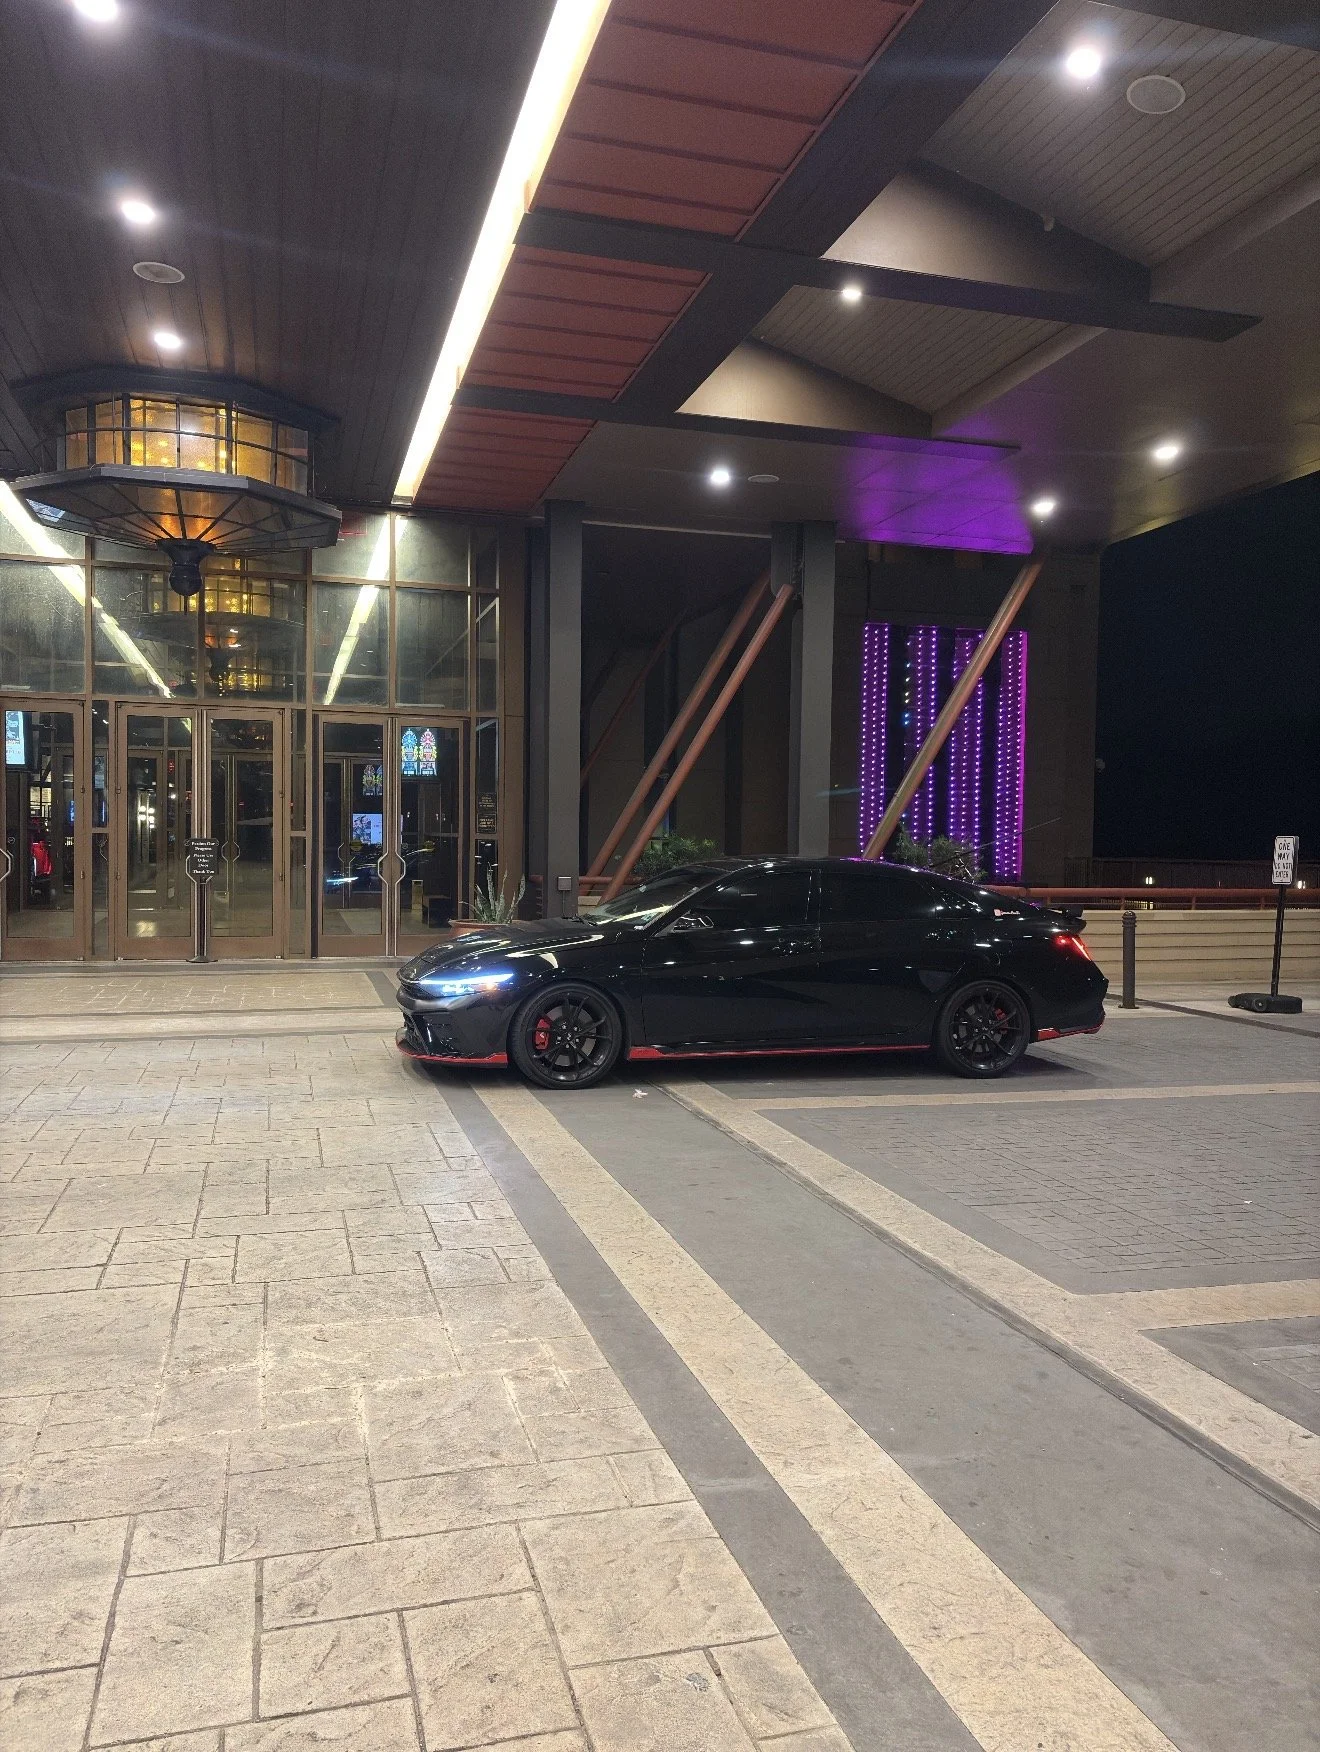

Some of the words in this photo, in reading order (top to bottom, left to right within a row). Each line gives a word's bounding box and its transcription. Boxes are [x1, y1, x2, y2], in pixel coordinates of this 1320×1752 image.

[1278, 842, 1291, 851] ONE
[1277, 852, 1290, 861] WAY
[1275, 870, 1289, 879] ENTER
